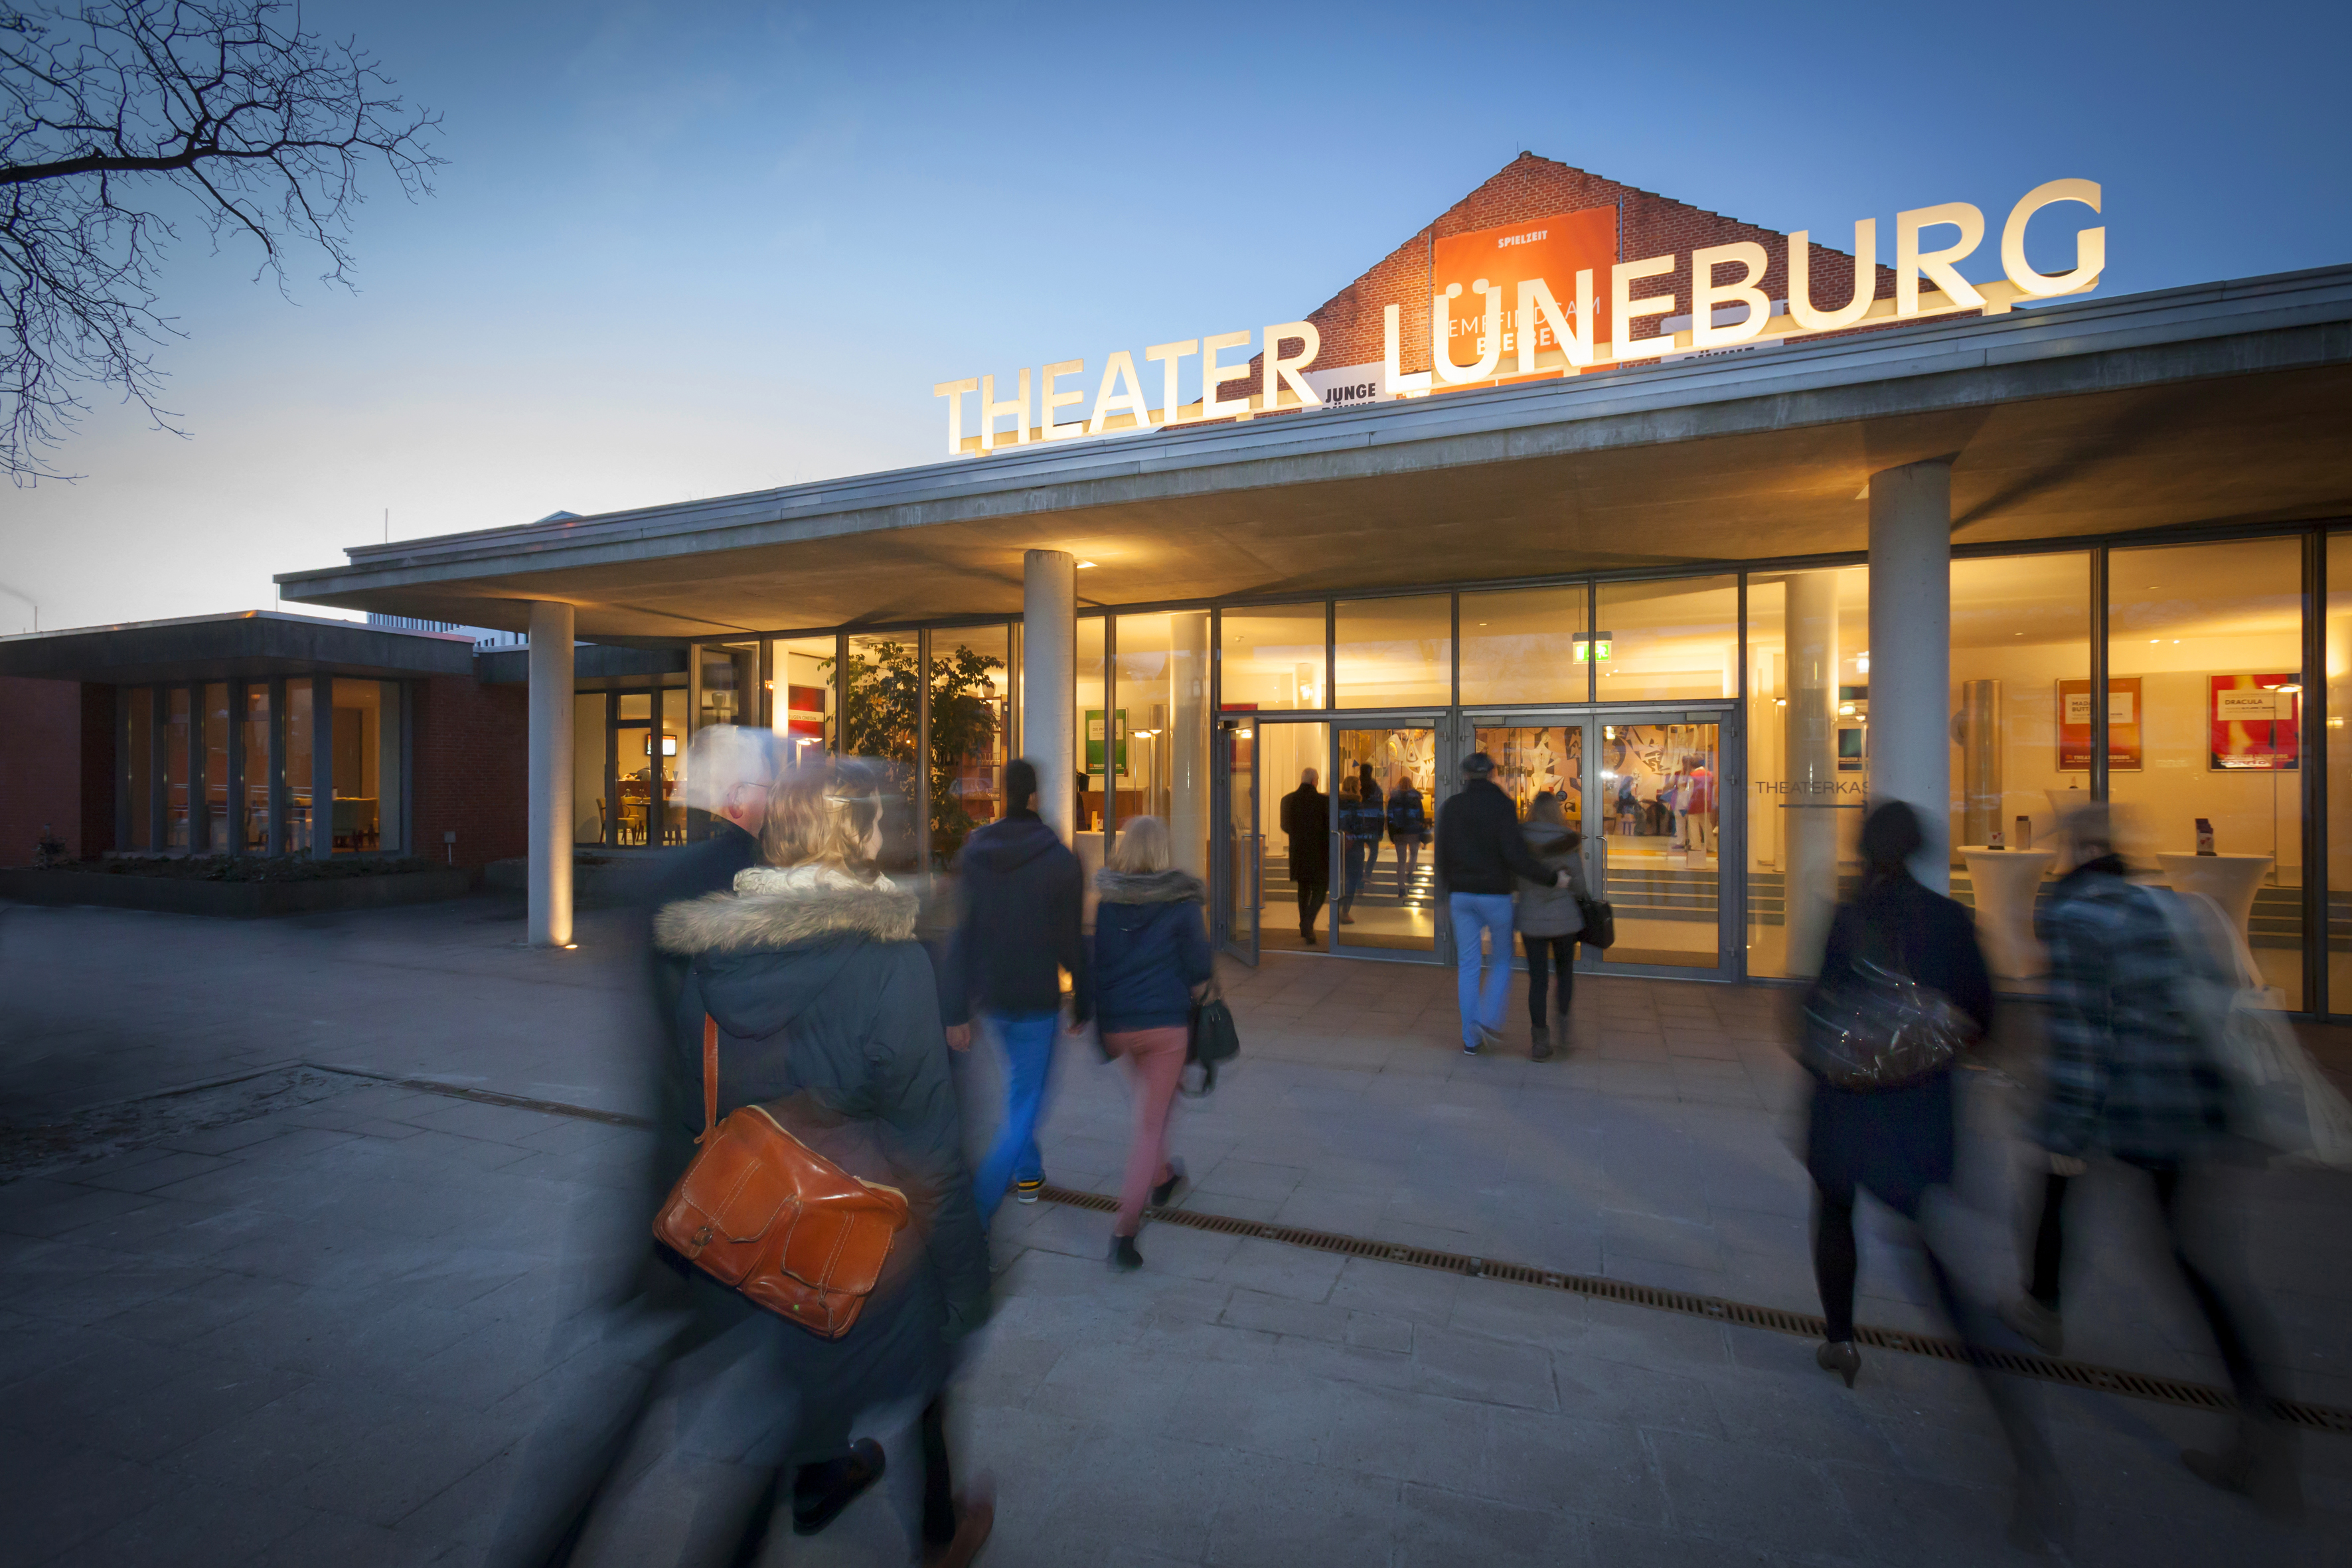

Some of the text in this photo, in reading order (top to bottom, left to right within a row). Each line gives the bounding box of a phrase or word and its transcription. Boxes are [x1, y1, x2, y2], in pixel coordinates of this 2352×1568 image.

[1498, 230, 1548, 249] SPIELZEIT
[934, 177, 2106, 455] THEATER LÜNEBURG
[1325, 382, 1376, 404] JUNGE
[1755, 781, 1869, 794] THEATERKAS
